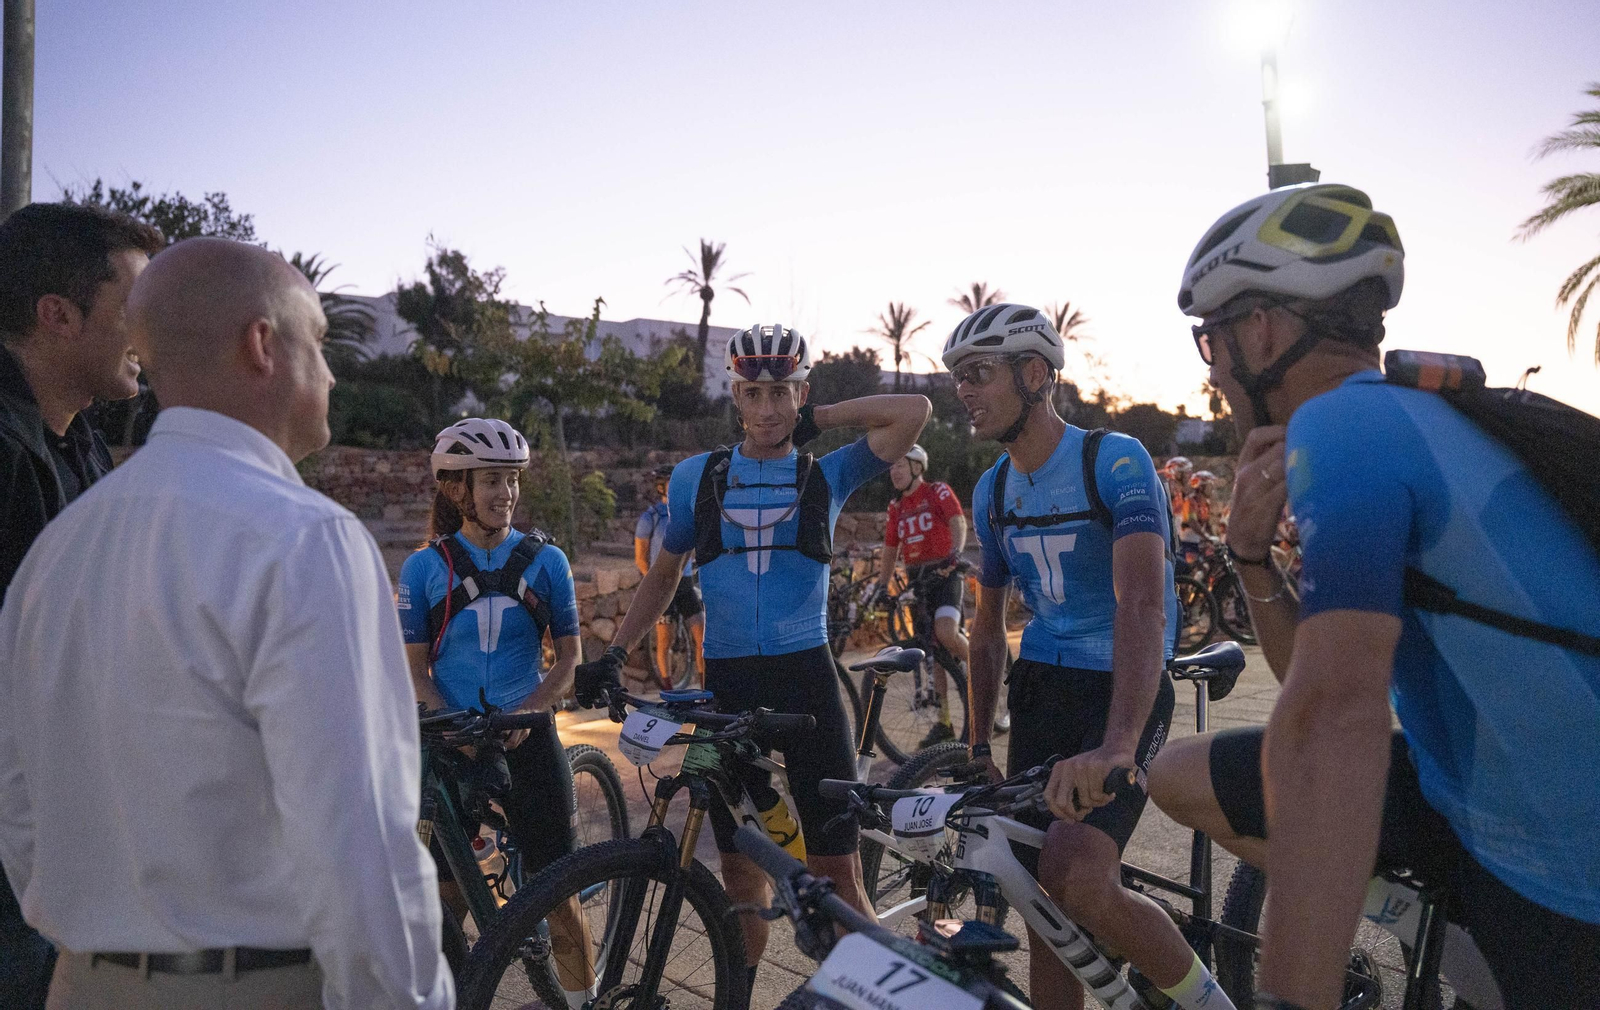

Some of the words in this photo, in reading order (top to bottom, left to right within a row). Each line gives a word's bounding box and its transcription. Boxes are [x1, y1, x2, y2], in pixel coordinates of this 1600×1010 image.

[1190, 240, 1245, 287] SCOTT
[1008, 323, 1046, 336] SCOTT
[1120, 488, 1146, 500] Activa
[897, 512, 933, 539] CTC
[642, 718, 658, 734] 9
[632, 733, 650, 744] DANIEL
[912, 796, 936, 818] 10
[904, 821, 918, 831] JUAN
[832, 975, 868, 999] JUAN
[874, 960, 930, 996] 17
